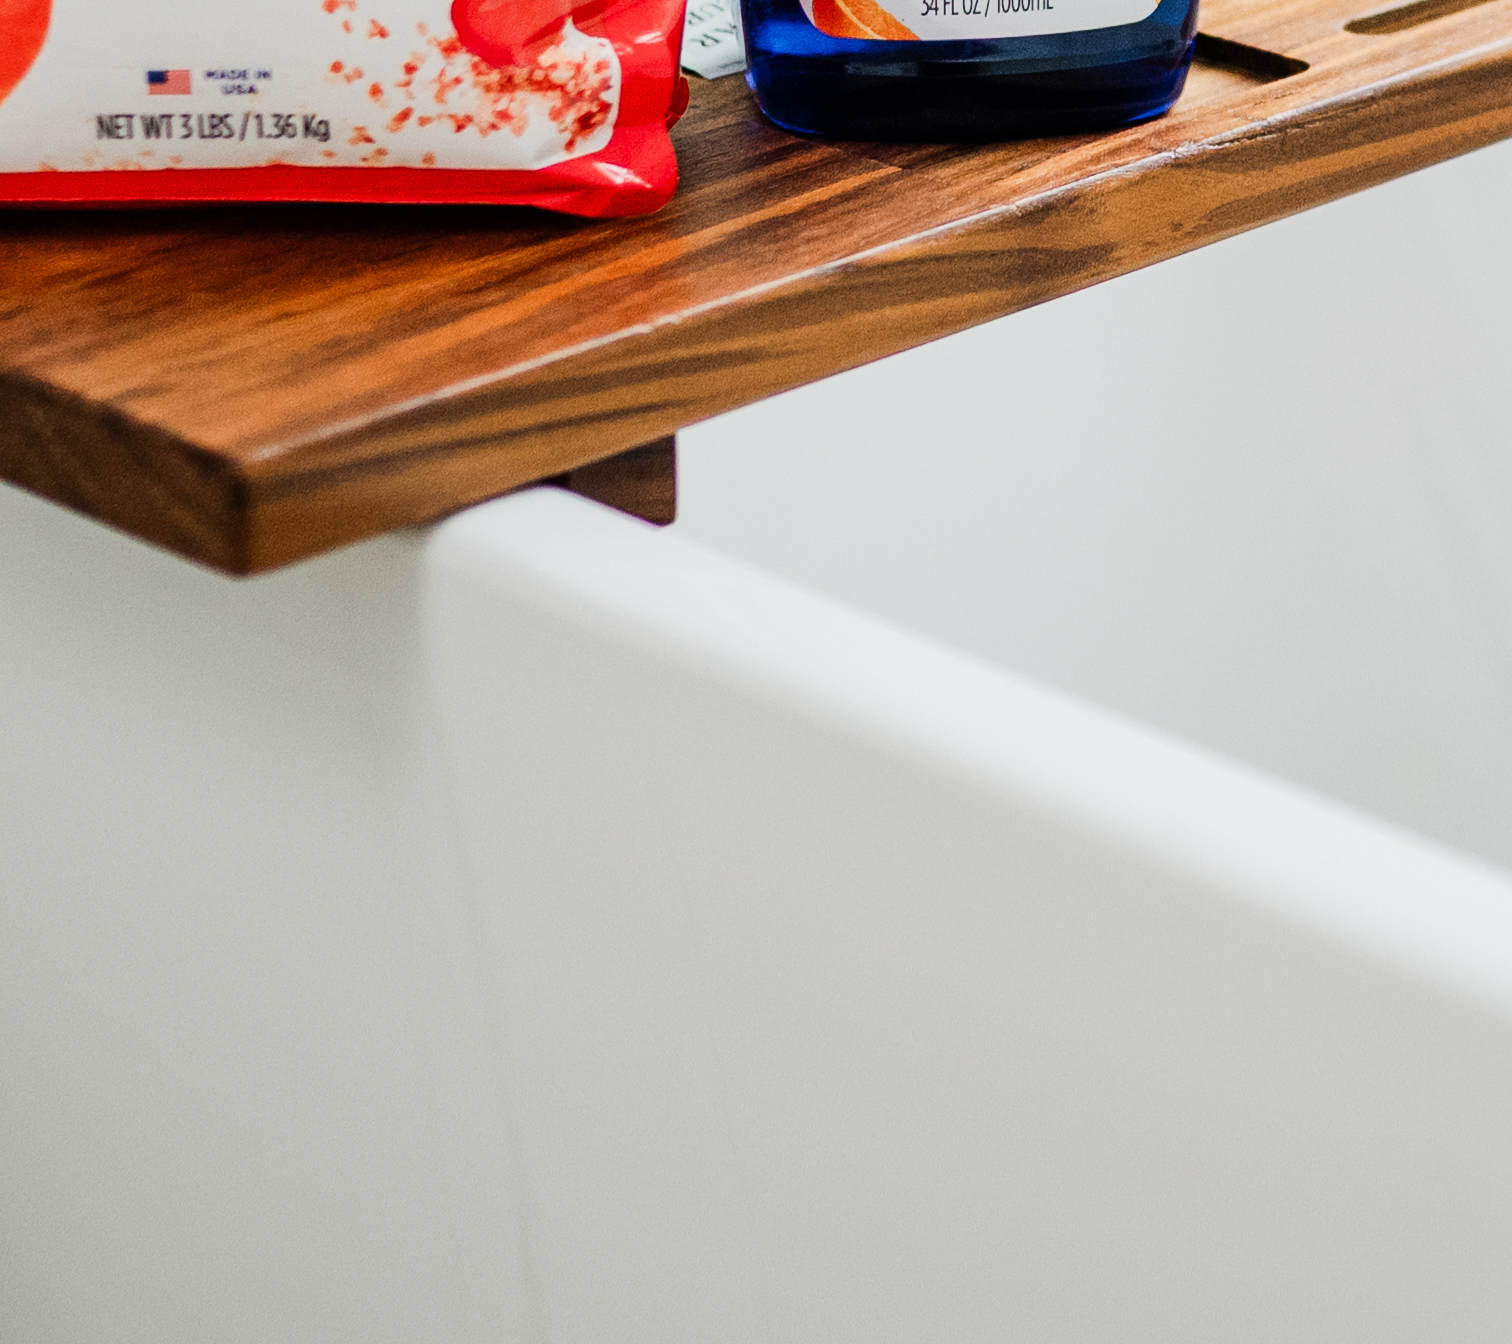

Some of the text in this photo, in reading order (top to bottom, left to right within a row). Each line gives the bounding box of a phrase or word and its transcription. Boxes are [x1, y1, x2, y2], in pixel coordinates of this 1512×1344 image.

[96, 113, 135, 139] NET
[141, 113, 173, 139] WT
[180, 113, 192, 139] 3
[198, 113, 235, 139] LBS
[255, 113, 297, 139] 1.36
[302, 113, 330, 142] Kg
